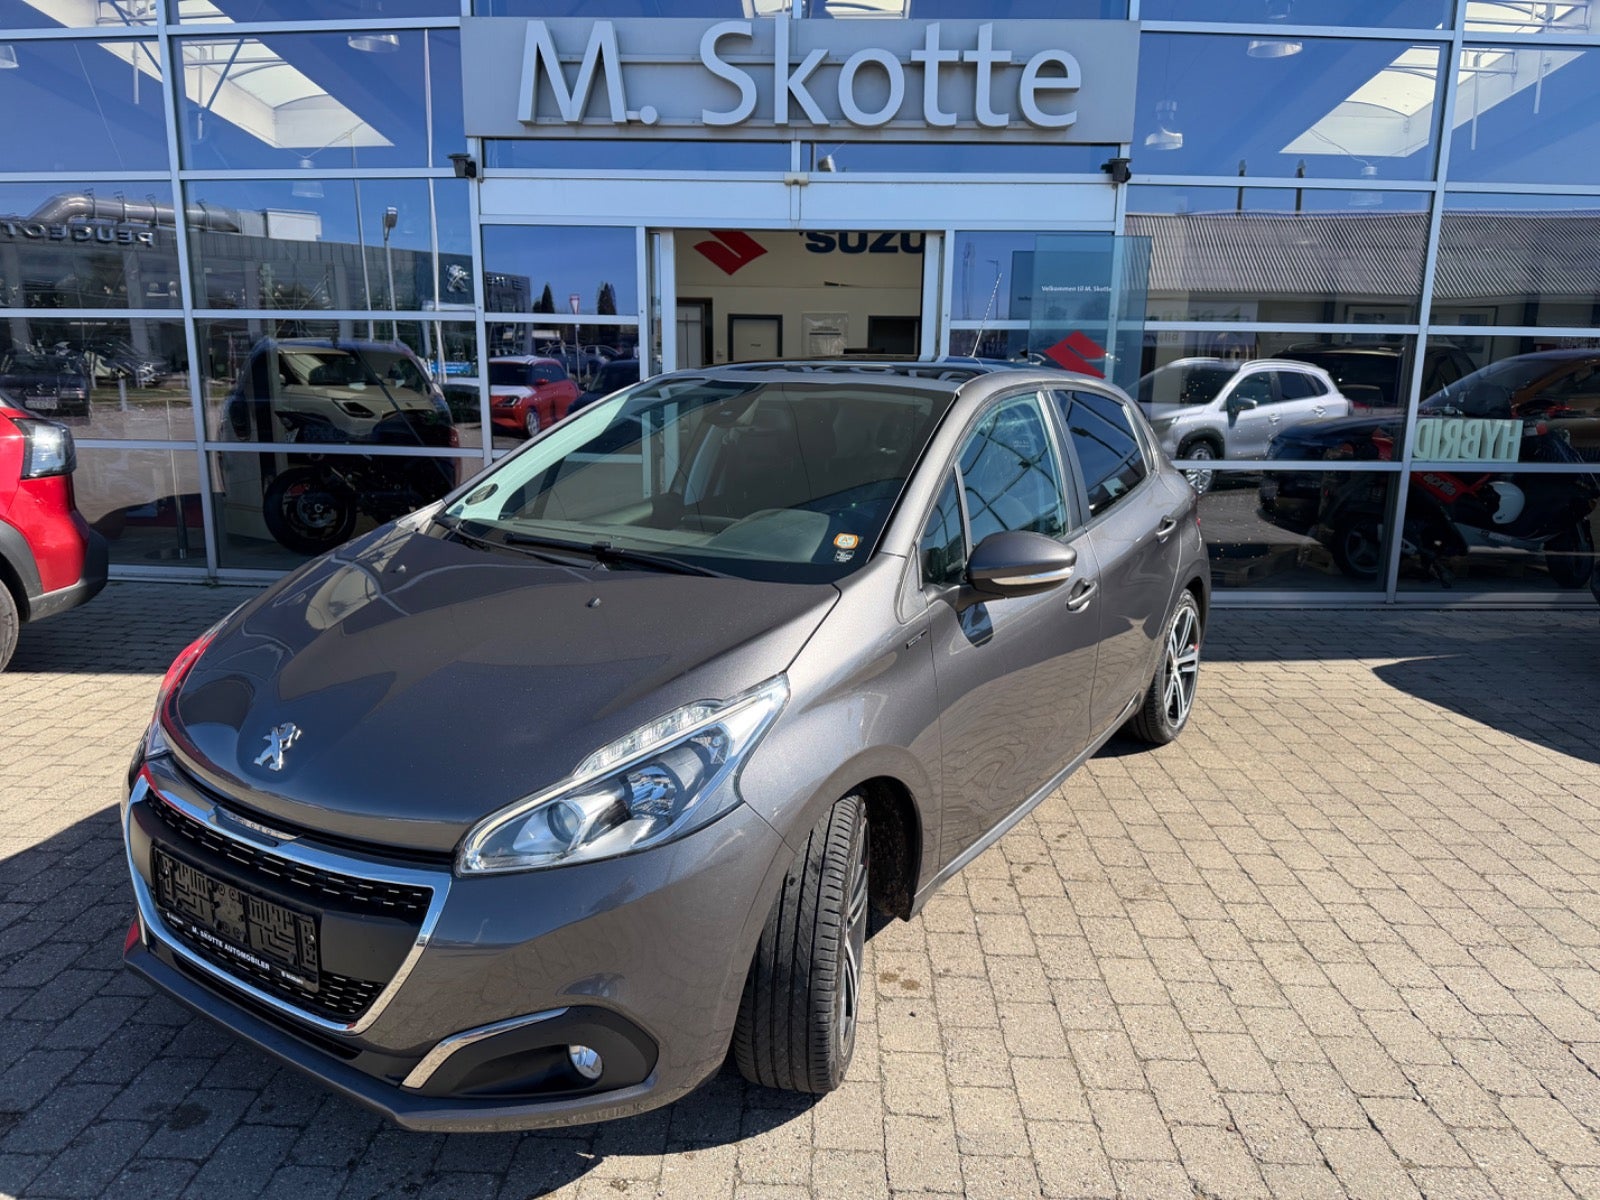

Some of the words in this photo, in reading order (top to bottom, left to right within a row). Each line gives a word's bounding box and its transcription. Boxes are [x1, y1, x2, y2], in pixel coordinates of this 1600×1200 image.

[518, 20, 660, 127] M.
[700, 13, 1083, 130] Skotte
[200, 930, 223, 948] SKOTTE
[224, 943, 271, 971] AUTOMOBILER
